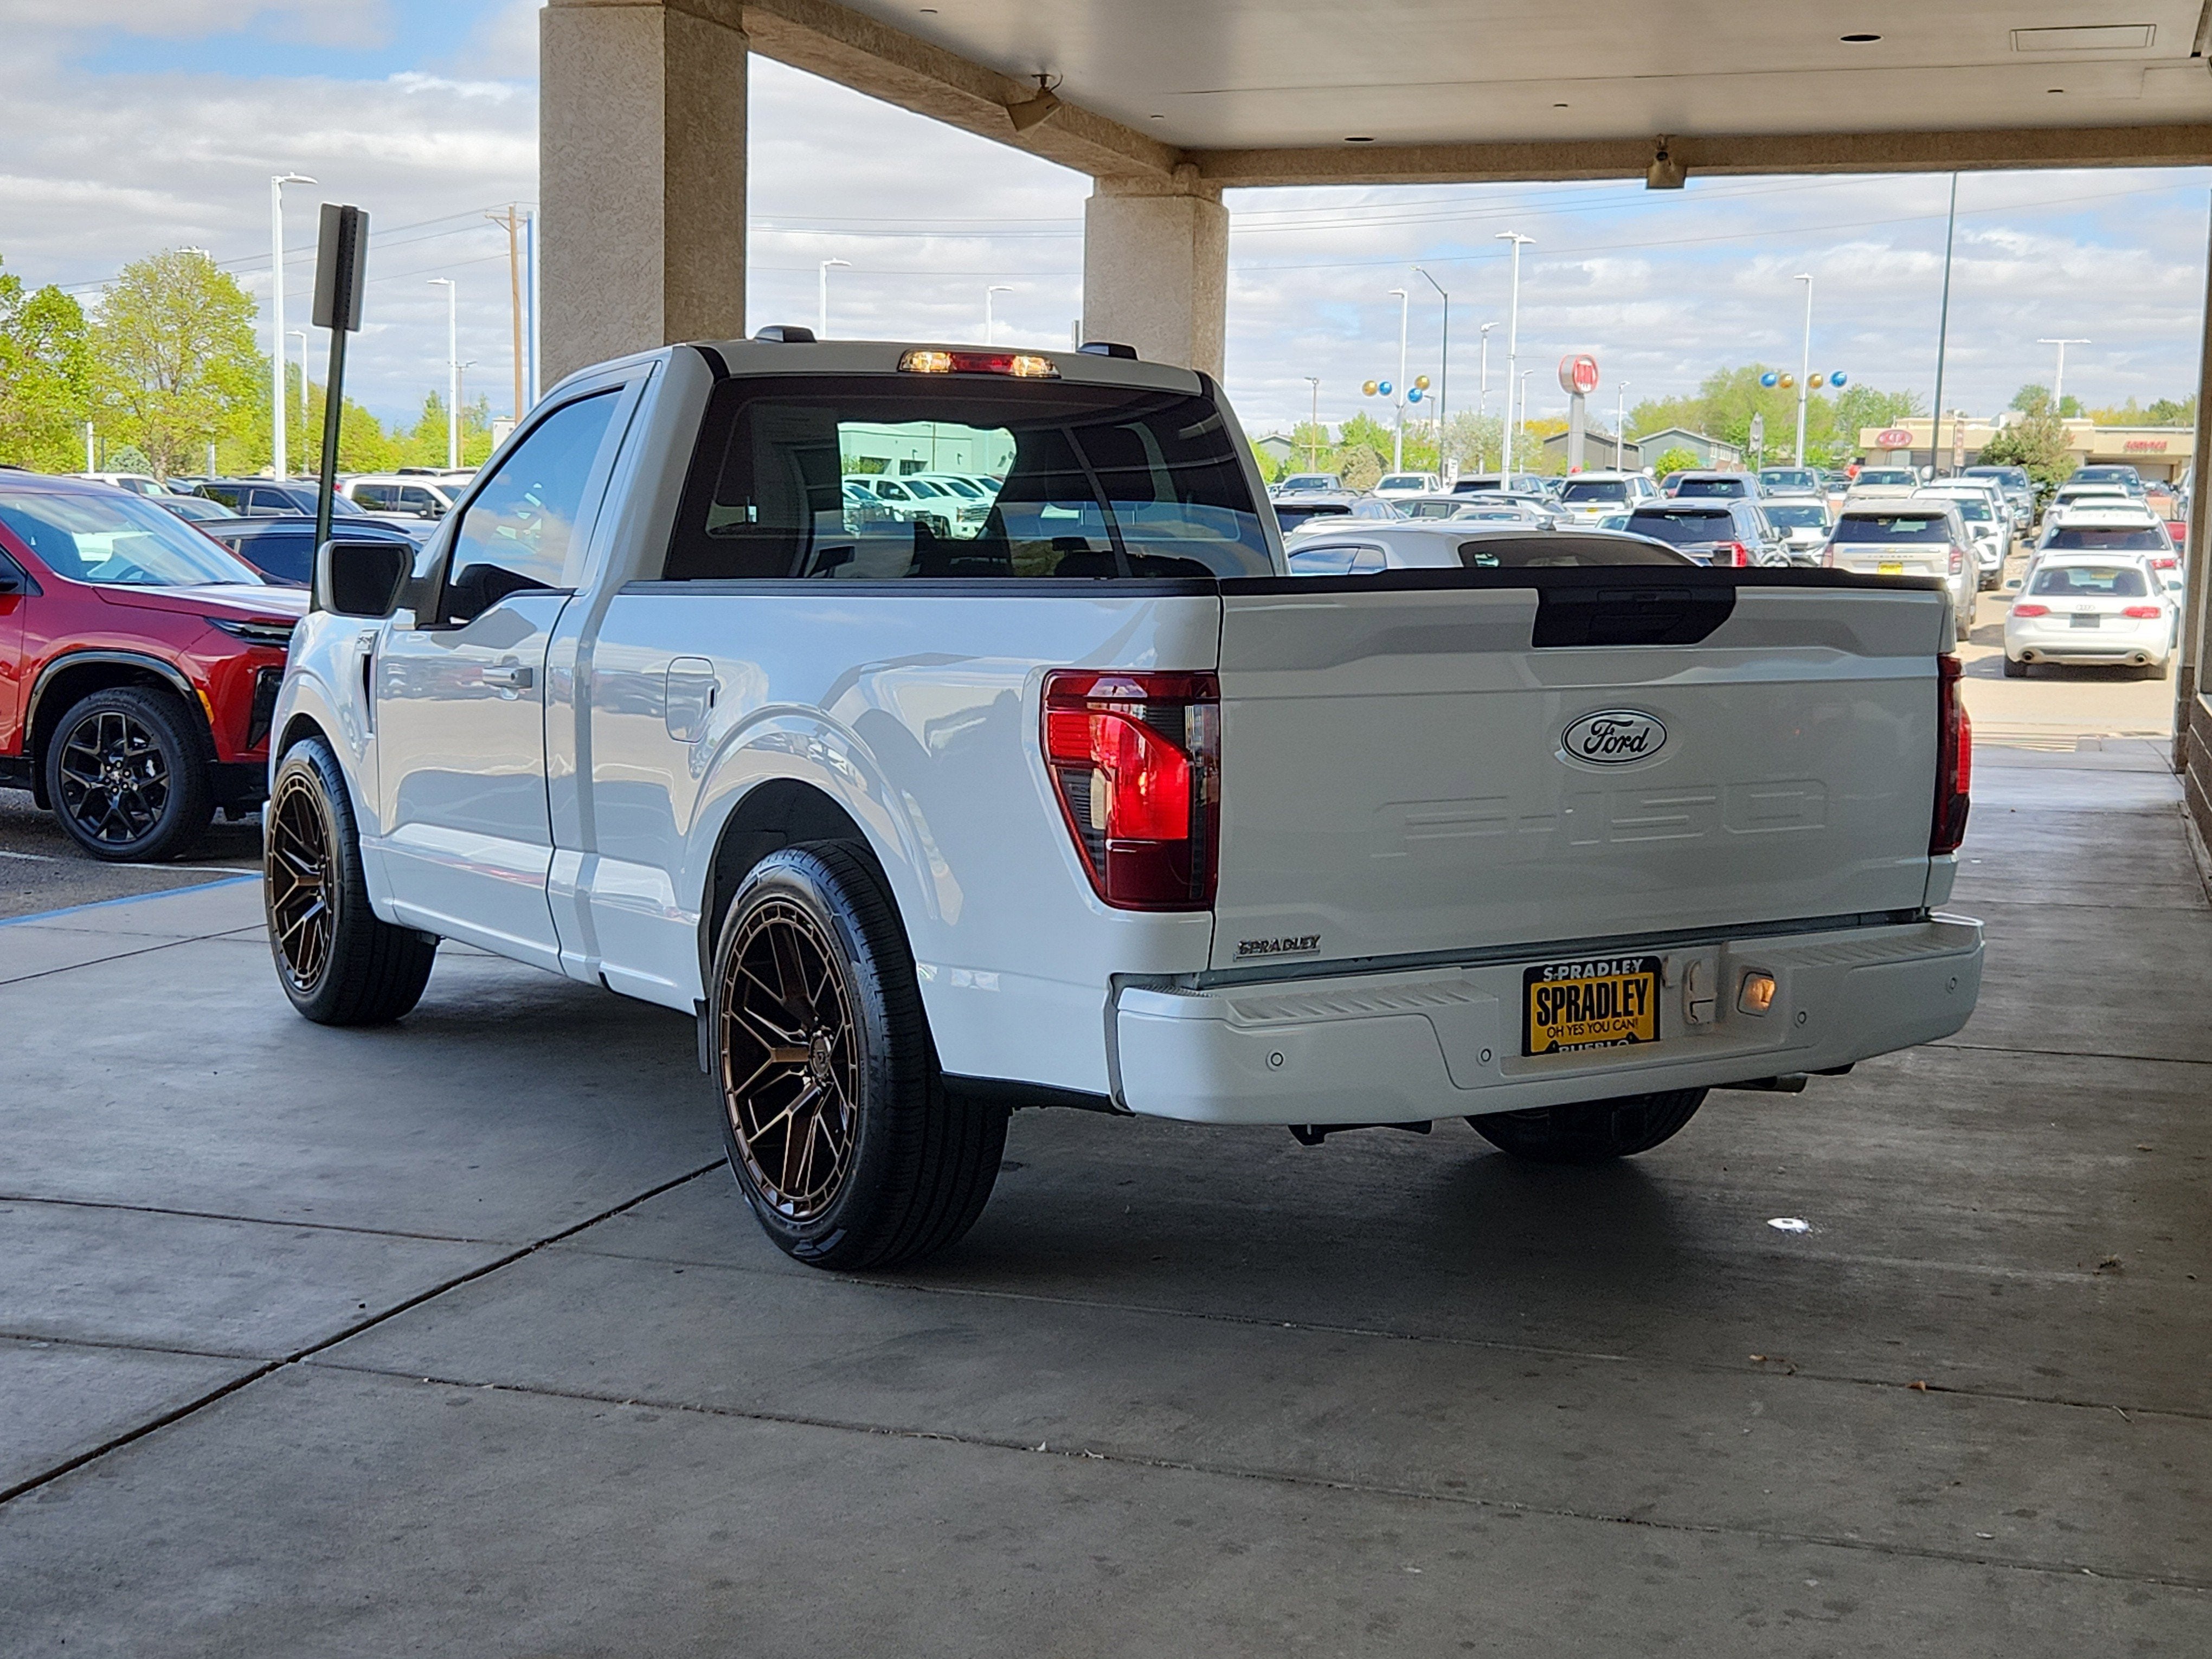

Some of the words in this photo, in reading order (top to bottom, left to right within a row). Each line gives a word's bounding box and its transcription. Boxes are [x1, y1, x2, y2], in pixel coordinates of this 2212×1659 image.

[1584, 719, 1650, 754] Ford
[1238, 934, 1321, 955] SPRADLEY
[1543, 959, 1643, 982] SPRADLEY
[1536, 978, 1649, 1027] SPRADLEY
[1547, 1026, 1564, 1038] OH
[1567, 1024, 1585, 1036] YES
[1587, 1021, 1610, 1034] YOU
[1612, 1017, 1639, 1031] CAN!
